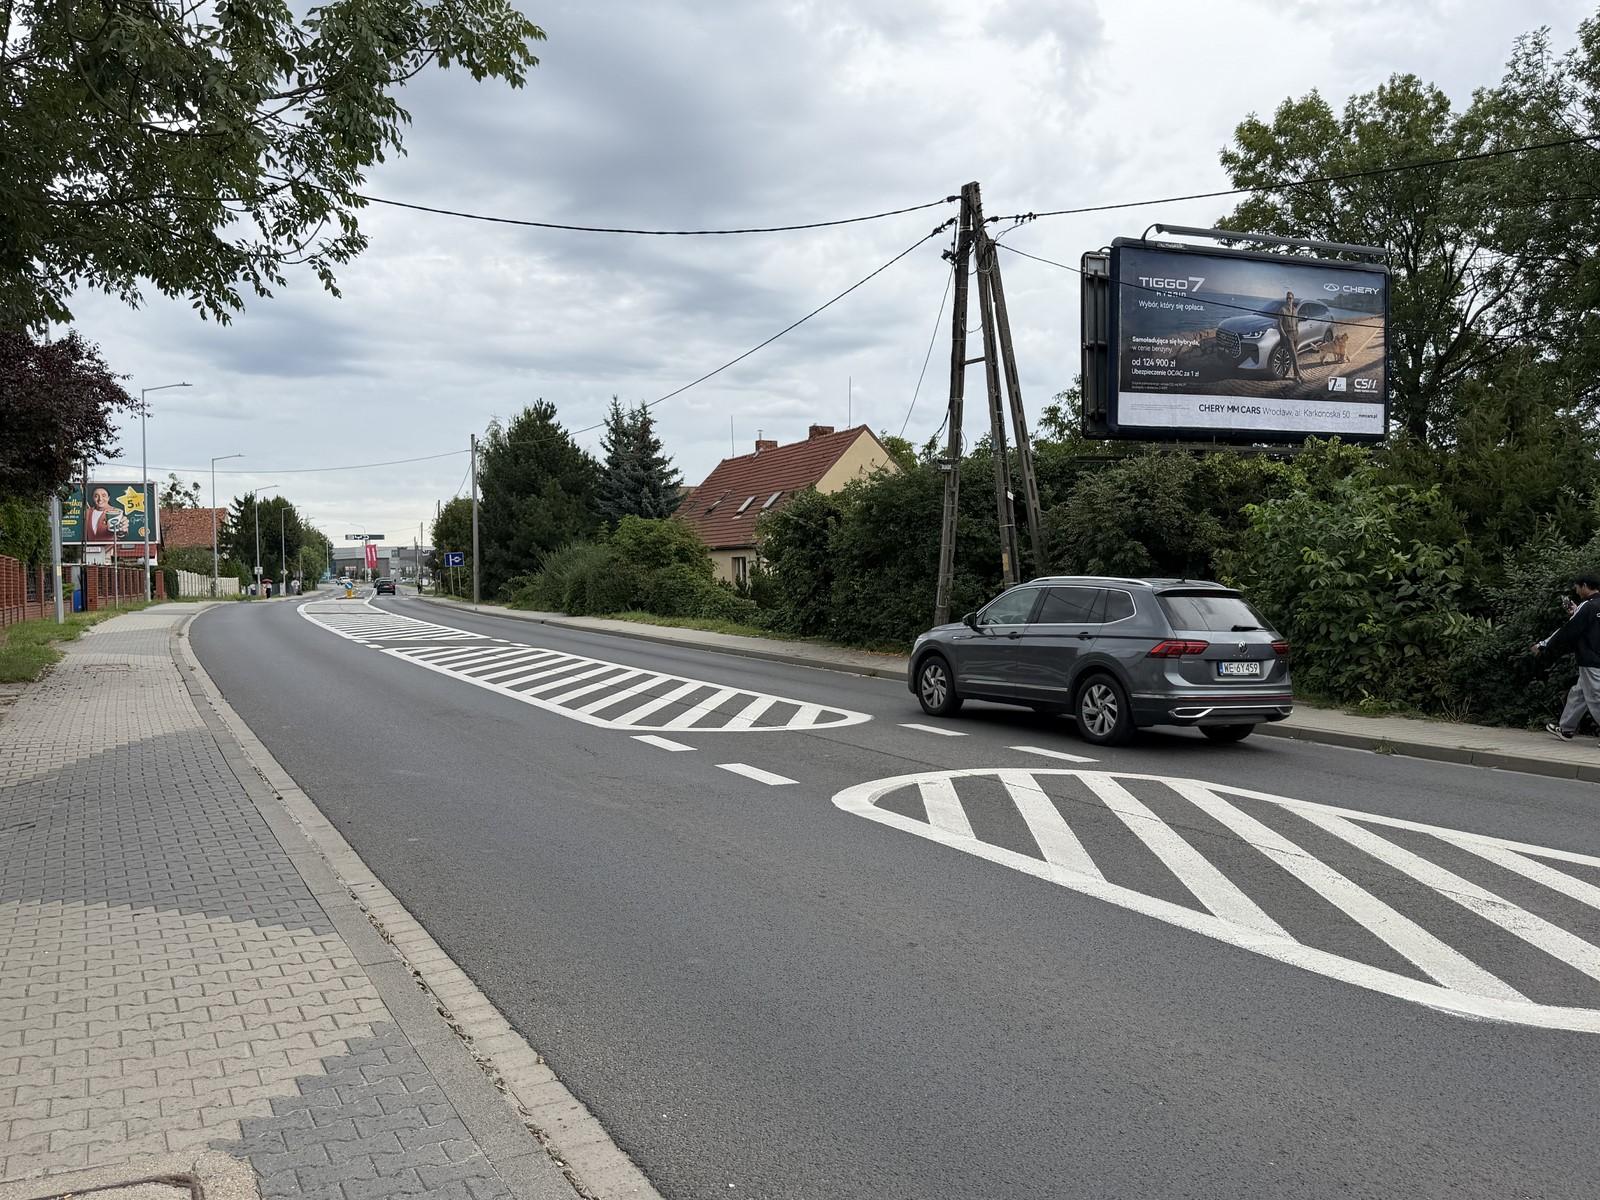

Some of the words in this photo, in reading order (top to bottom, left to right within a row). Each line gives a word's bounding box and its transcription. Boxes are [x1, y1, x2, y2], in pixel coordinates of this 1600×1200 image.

[1138, 276, 1188, 290] TIGGO
[1188, 276, 1206, 293] 7
[1342, 285, 1380, 295] CHERY
[1138, 300, 1159, 309] Wybór,
[1160, 301, 1175, 311] który
[1175, 302, 1184, 312] się
[1132, 336, 1169, 345] Samoładująca
[1169, 338, 1177, 346] się
[1131, 358, 1141, 366] od
[1142, 358, 1155, 367] 124
[1155, 358, 1169, 367] 900
[1170, 359, 1176, 367] zł
[1131, 368, 1167, 376] Ubezpieczenie
[1329, 377, 1338, 391] 7
[1198, 403, 1225, 413] CHERY
[1226, 405, 1240, 413] MM
[1240, 405, 1261, 415] CARS
[1262, 407, 1294, 417] Wrocław,
[1303, 409, 1341, 419] Karkonoska
[1342, 410, 1351, 419] 50
[127, 499, 135, 509] 5
[1223, 663, 1234, 673] WE
[1236, 663, 1258, 673] 6Y459
